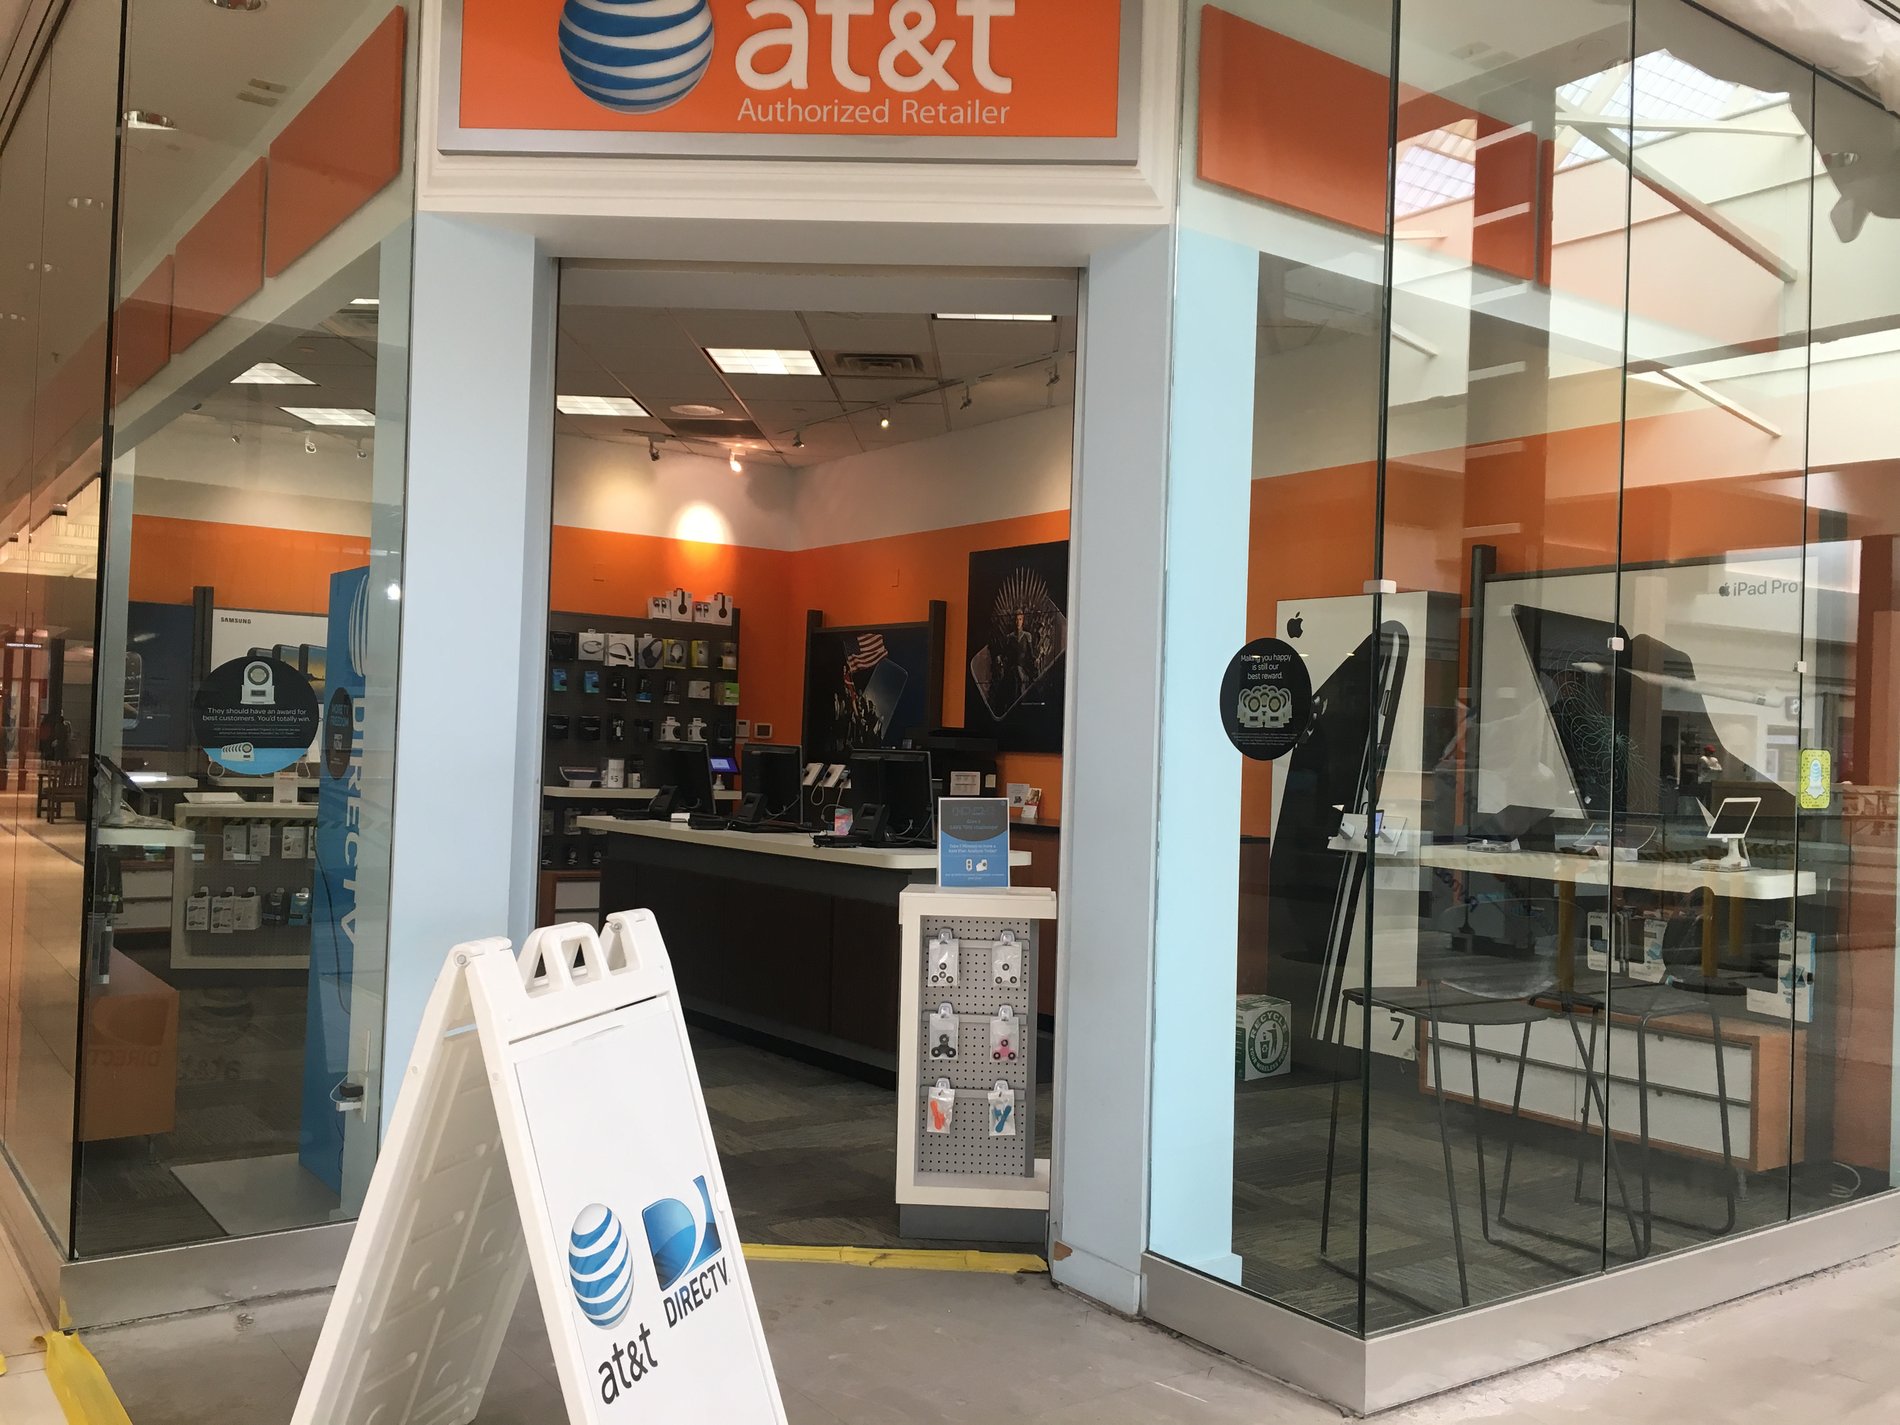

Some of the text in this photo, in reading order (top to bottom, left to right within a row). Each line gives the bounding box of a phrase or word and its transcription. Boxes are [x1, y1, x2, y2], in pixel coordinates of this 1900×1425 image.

[735, 0, 1015, 93] at&t
[737, 98, 1010, 124] Authorized Retailer
[1733, 579, 1799, 596] iPad Pro
[220, 616, 252, 625] SAMSUNG
[1258, 662, 1268, 670] still
[1273, 653, 1291, 662] happy
[1247, 672, 1260, 680] best
[207, 707, 225, 715] They
[226, 707, 249, 715] should
[276, 715, 297, 723] totally
[1250, 1011, 1289, 1039] RECYCLE
[1391, 1017, 1405, 1041] 7
[663, 1257, 729, 1328] DIRECTV
[598, 1322, 658, 1405] at&t
